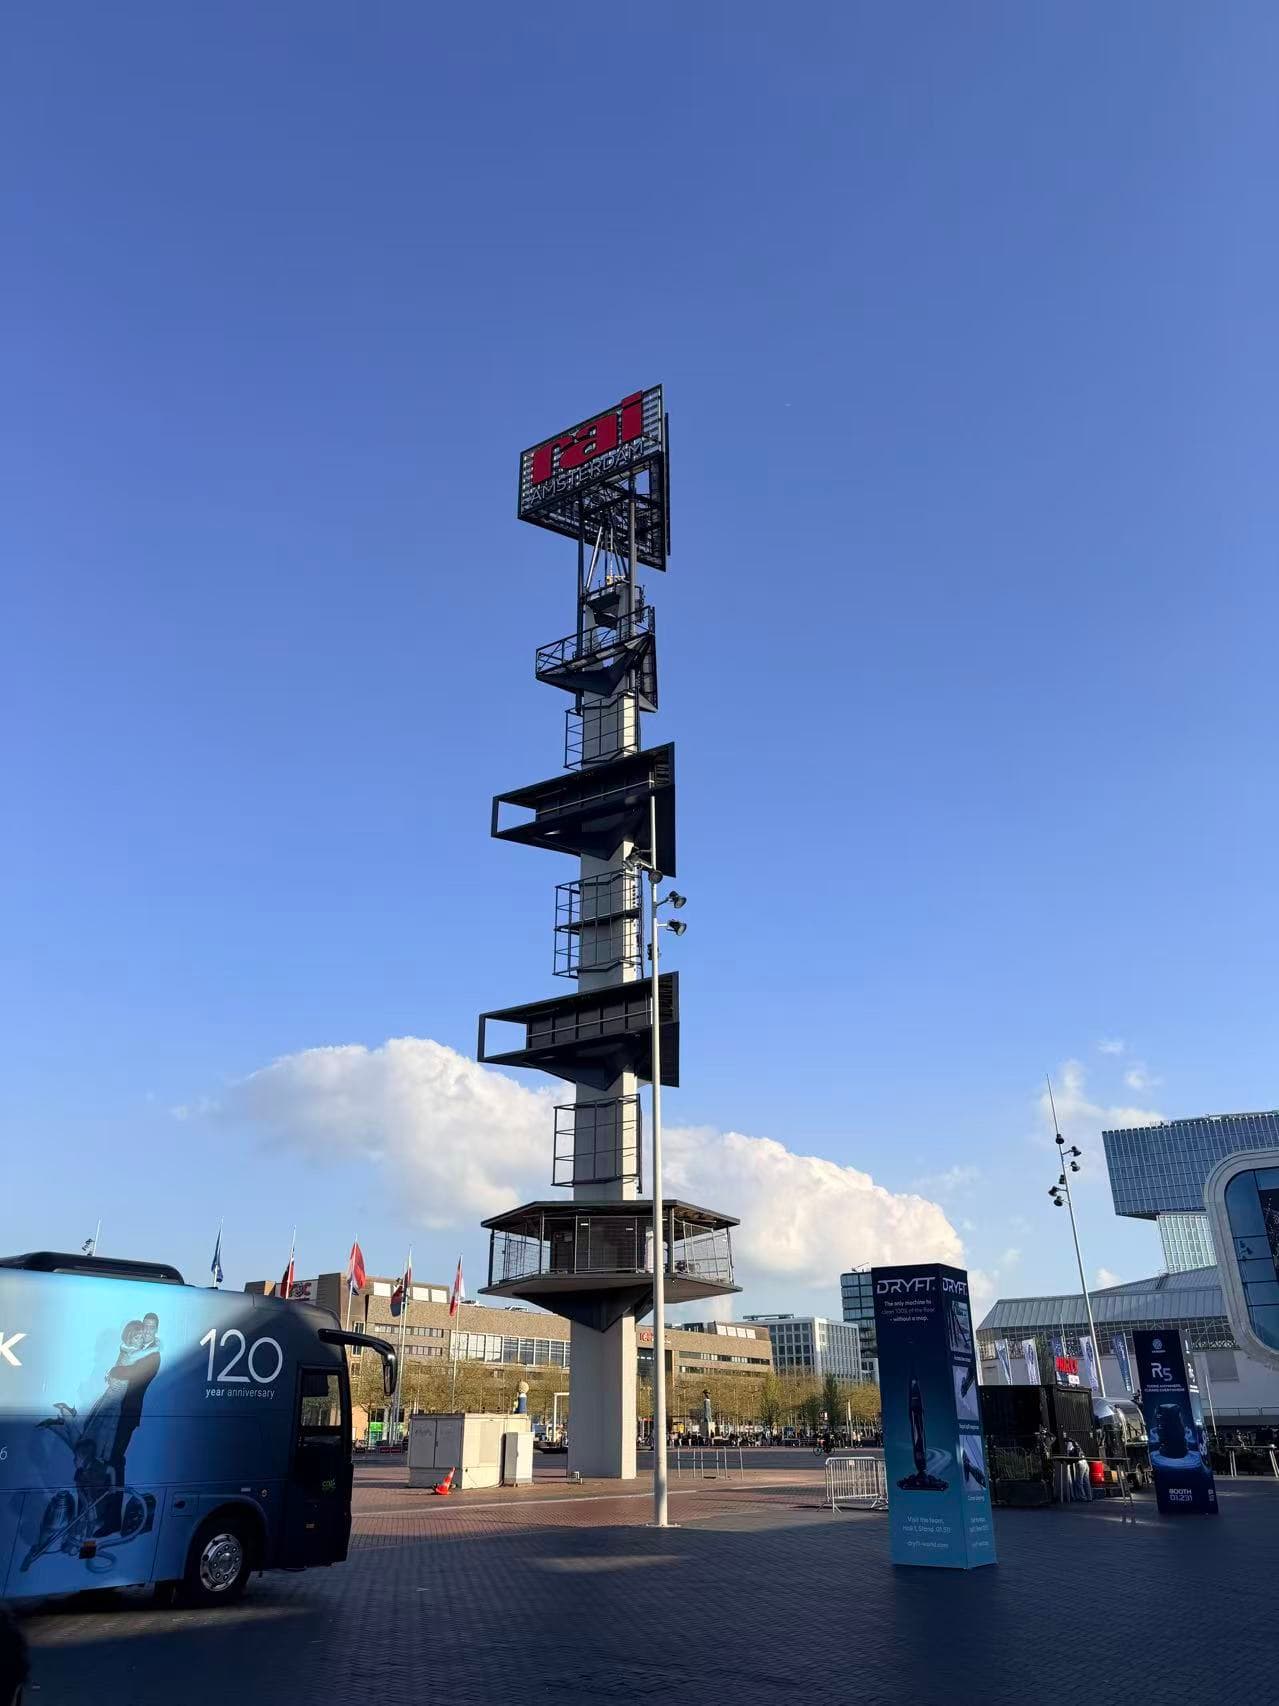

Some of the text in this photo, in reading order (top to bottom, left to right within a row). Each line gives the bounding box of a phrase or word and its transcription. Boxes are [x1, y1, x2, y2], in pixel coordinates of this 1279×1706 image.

[531, 390, 643, 485] rai
[530, 443, 644, 503] AMSTERDAM
[200, 1329, 283, 1384] 120
[1151, 1362, 1173, 1381] R5
[206, 1388, 275, 1399] year anniversary
[907, 1515, 919, 1523] Visit
